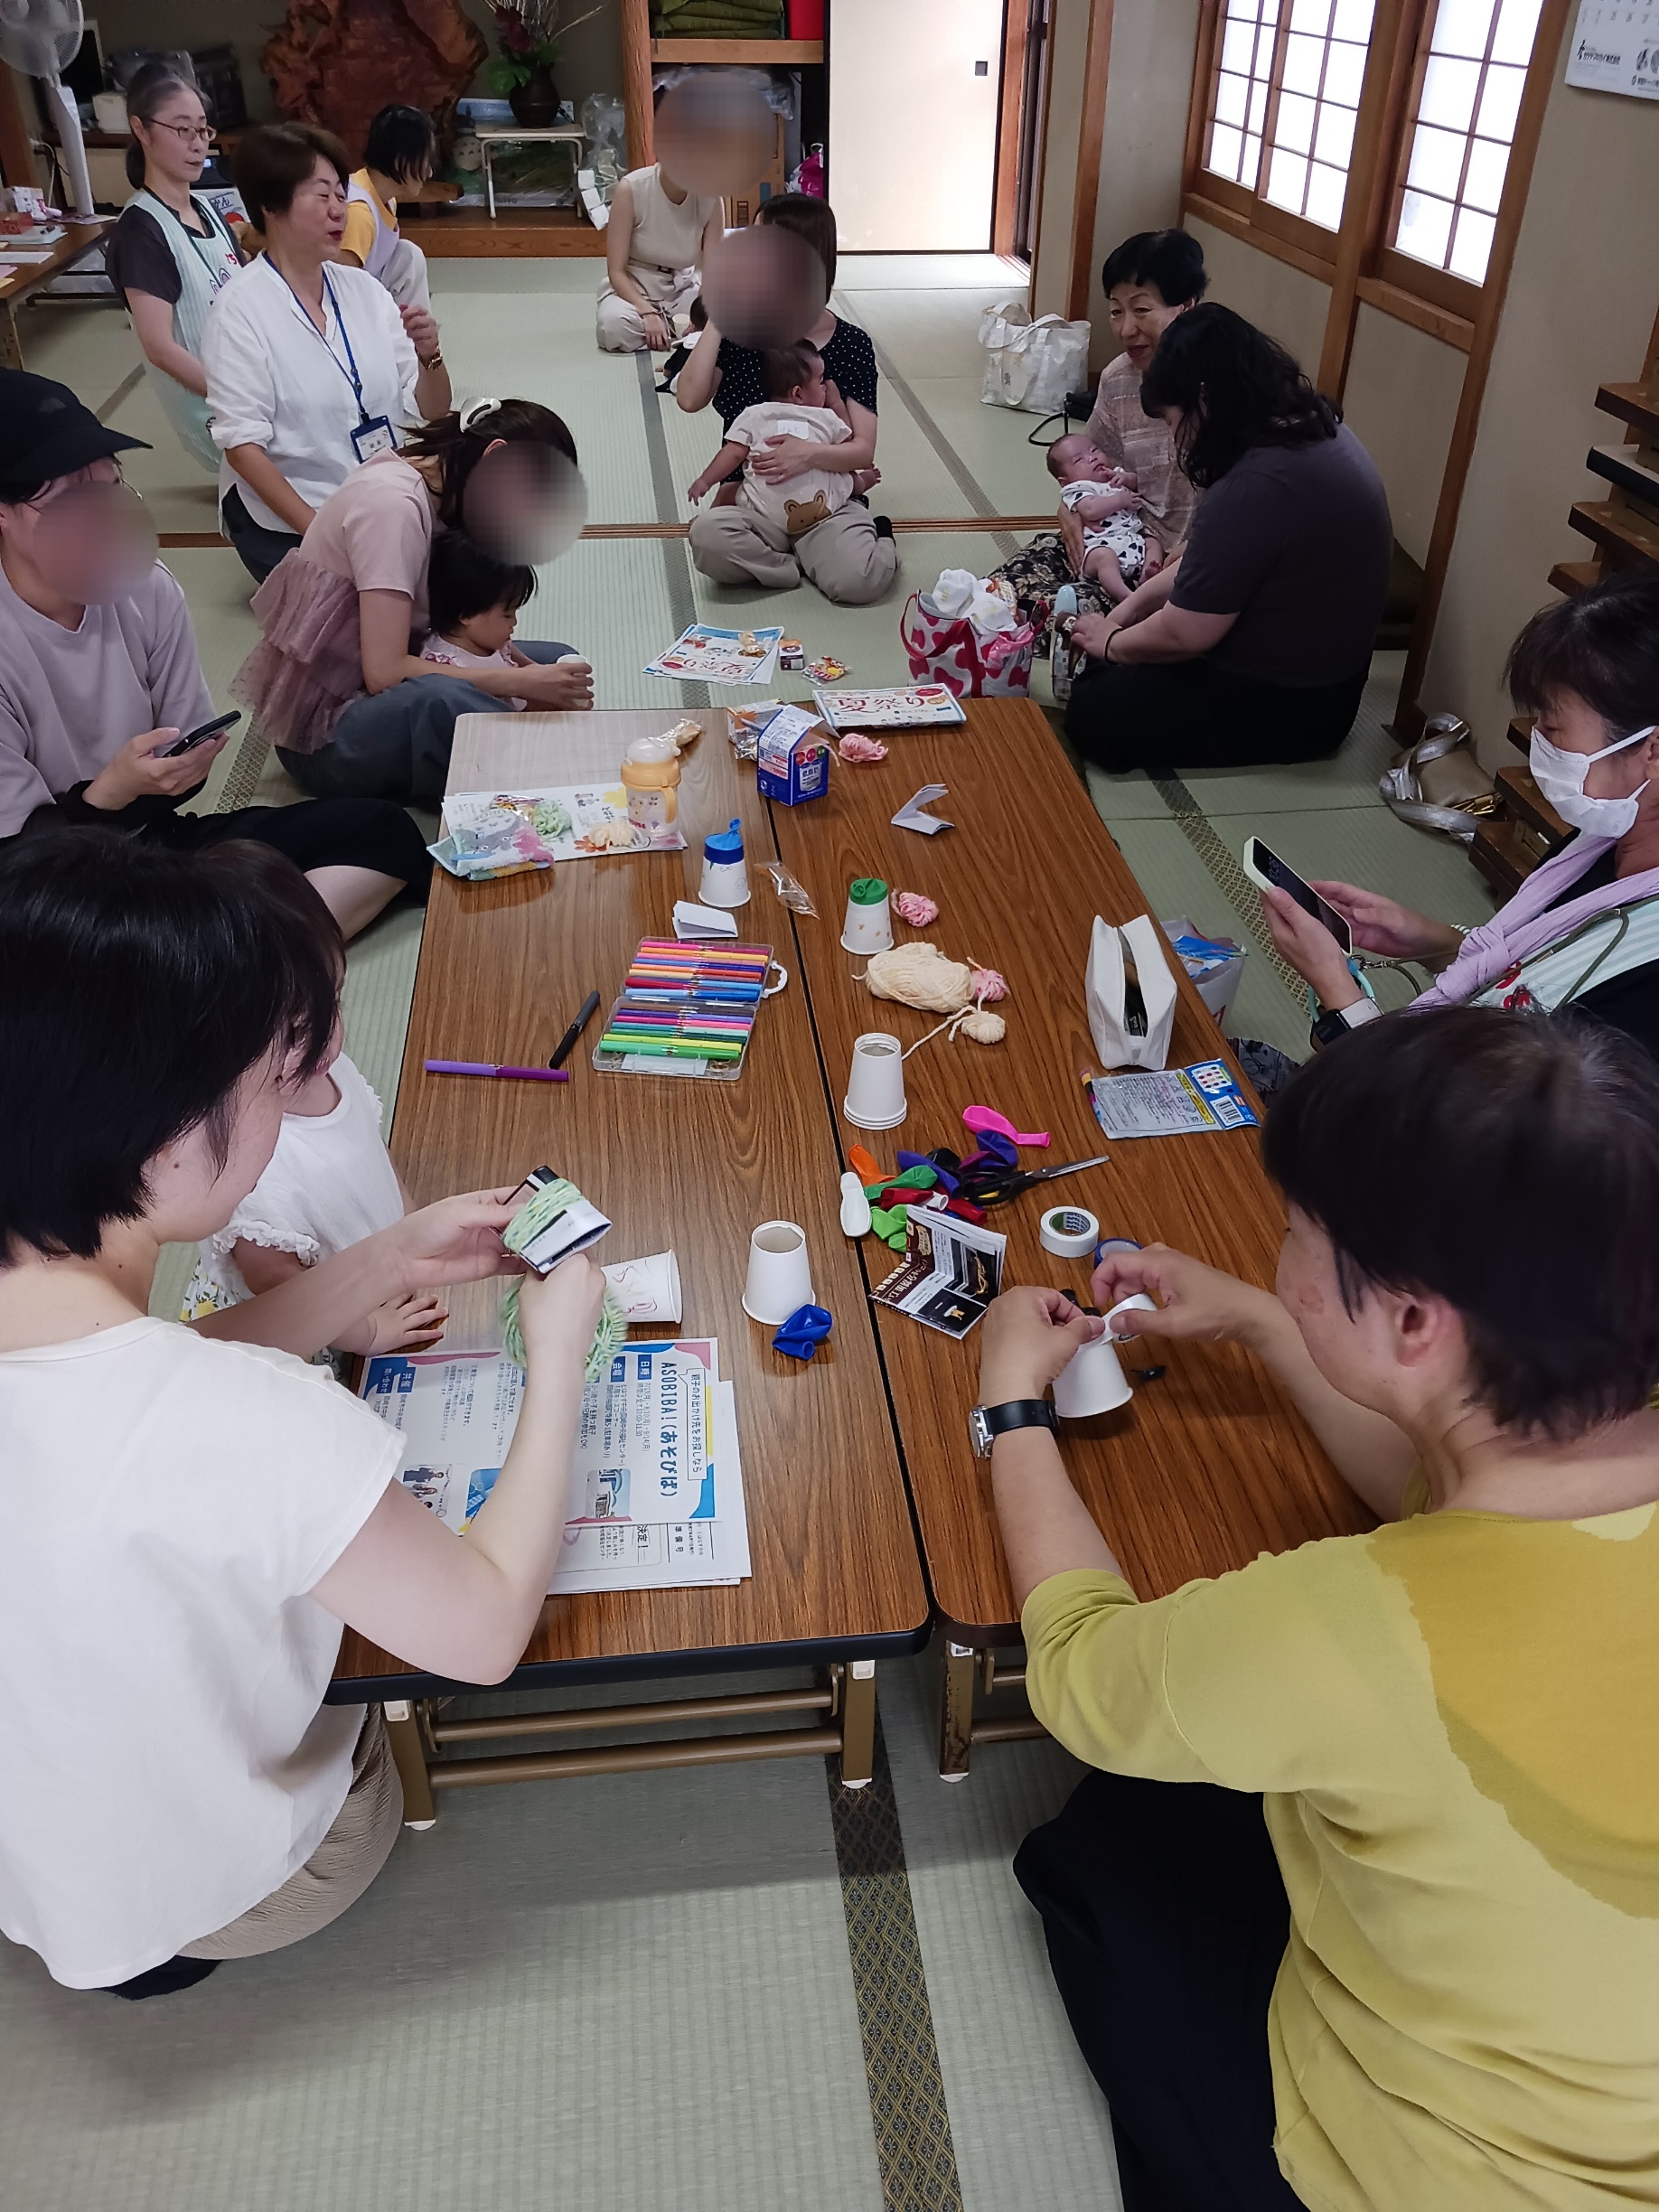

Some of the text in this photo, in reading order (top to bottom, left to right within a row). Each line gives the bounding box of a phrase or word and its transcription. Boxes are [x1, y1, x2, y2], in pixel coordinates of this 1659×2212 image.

[830, 695, 925, 714] 夏祭り
[640, 1360, 650, 1375] 日時
[380, 1367, 392, 1393] 問い合わせ
[400, 1373, 413, 1388] 共催
[660, 1362, 679, 1497] ASOBIBA!(あそびば)
[690, 1373, 703, 1474] 親子のお出かけ先をお探しなら
